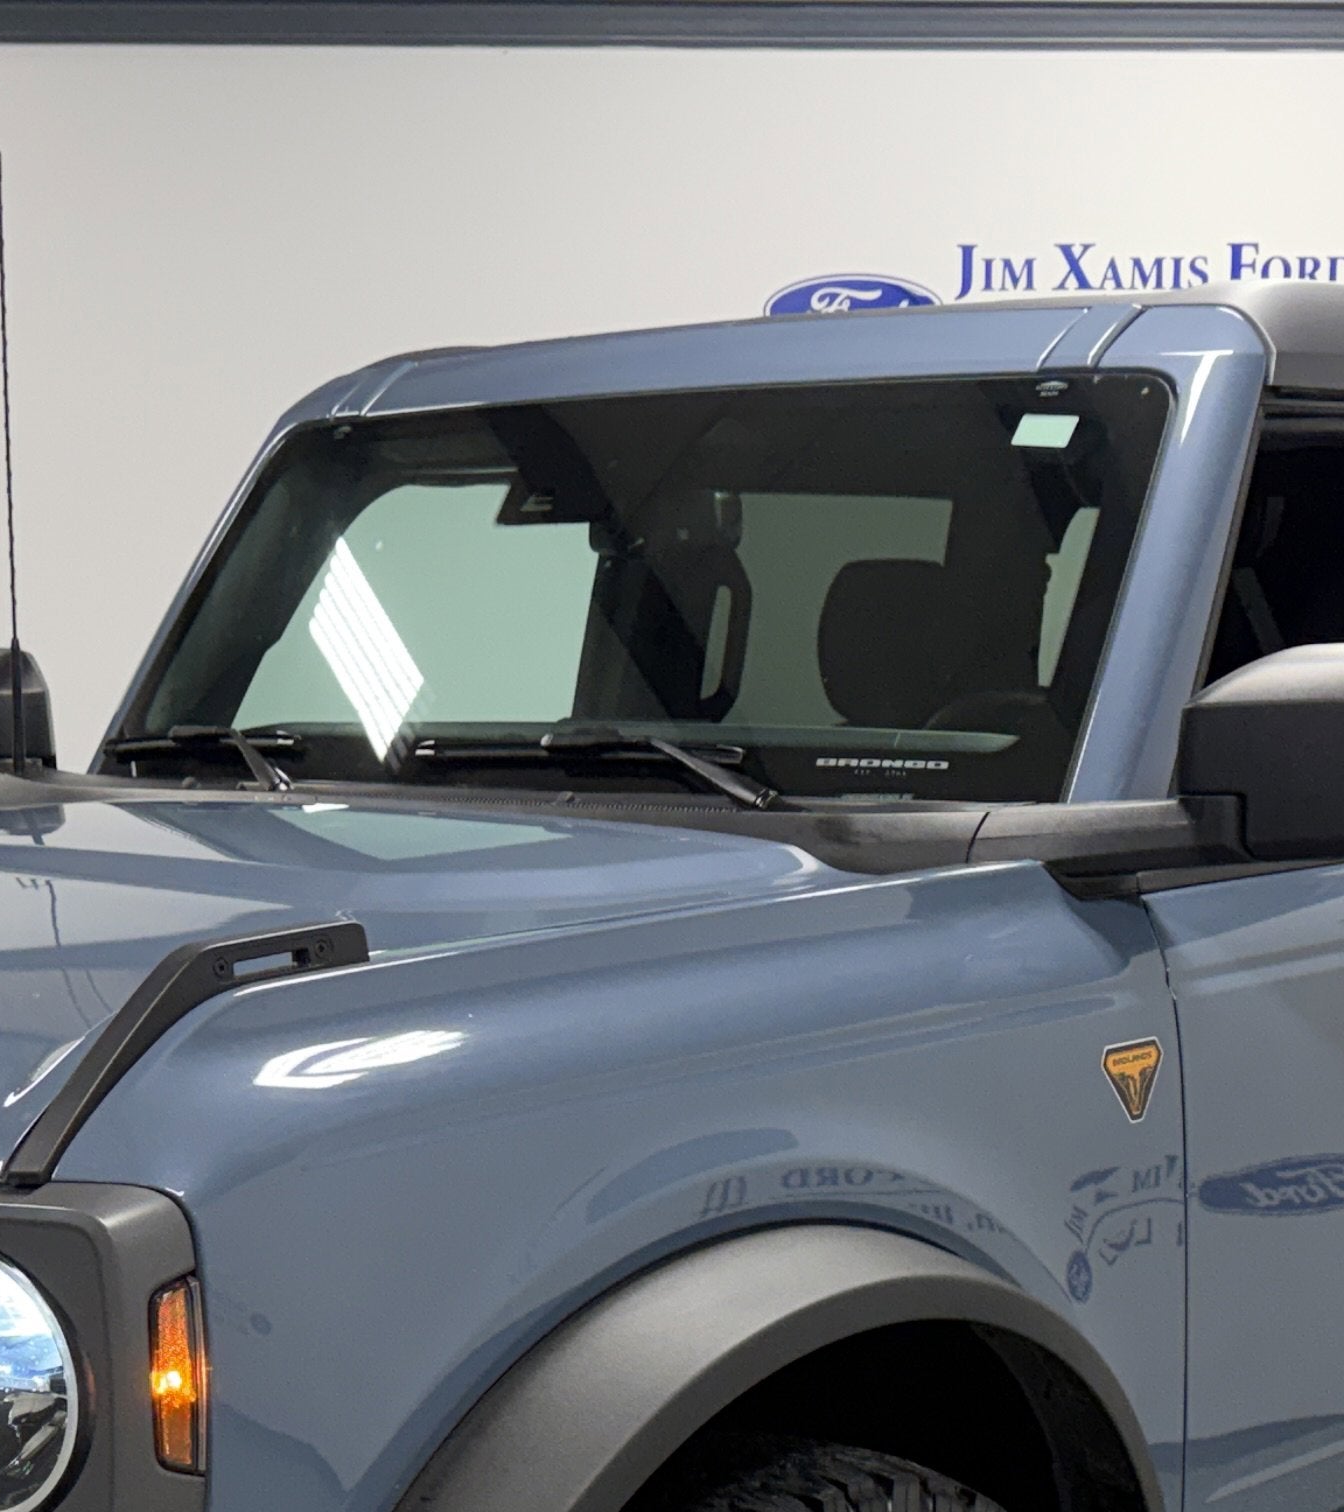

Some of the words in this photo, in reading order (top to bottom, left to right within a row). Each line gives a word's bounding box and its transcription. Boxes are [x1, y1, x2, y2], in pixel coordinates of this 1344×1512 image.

[956, 243, 1036, 300] JIM
[1054, 243, 1209, 291] XAMIS
[816, 758, 949, 770] BRONCO
